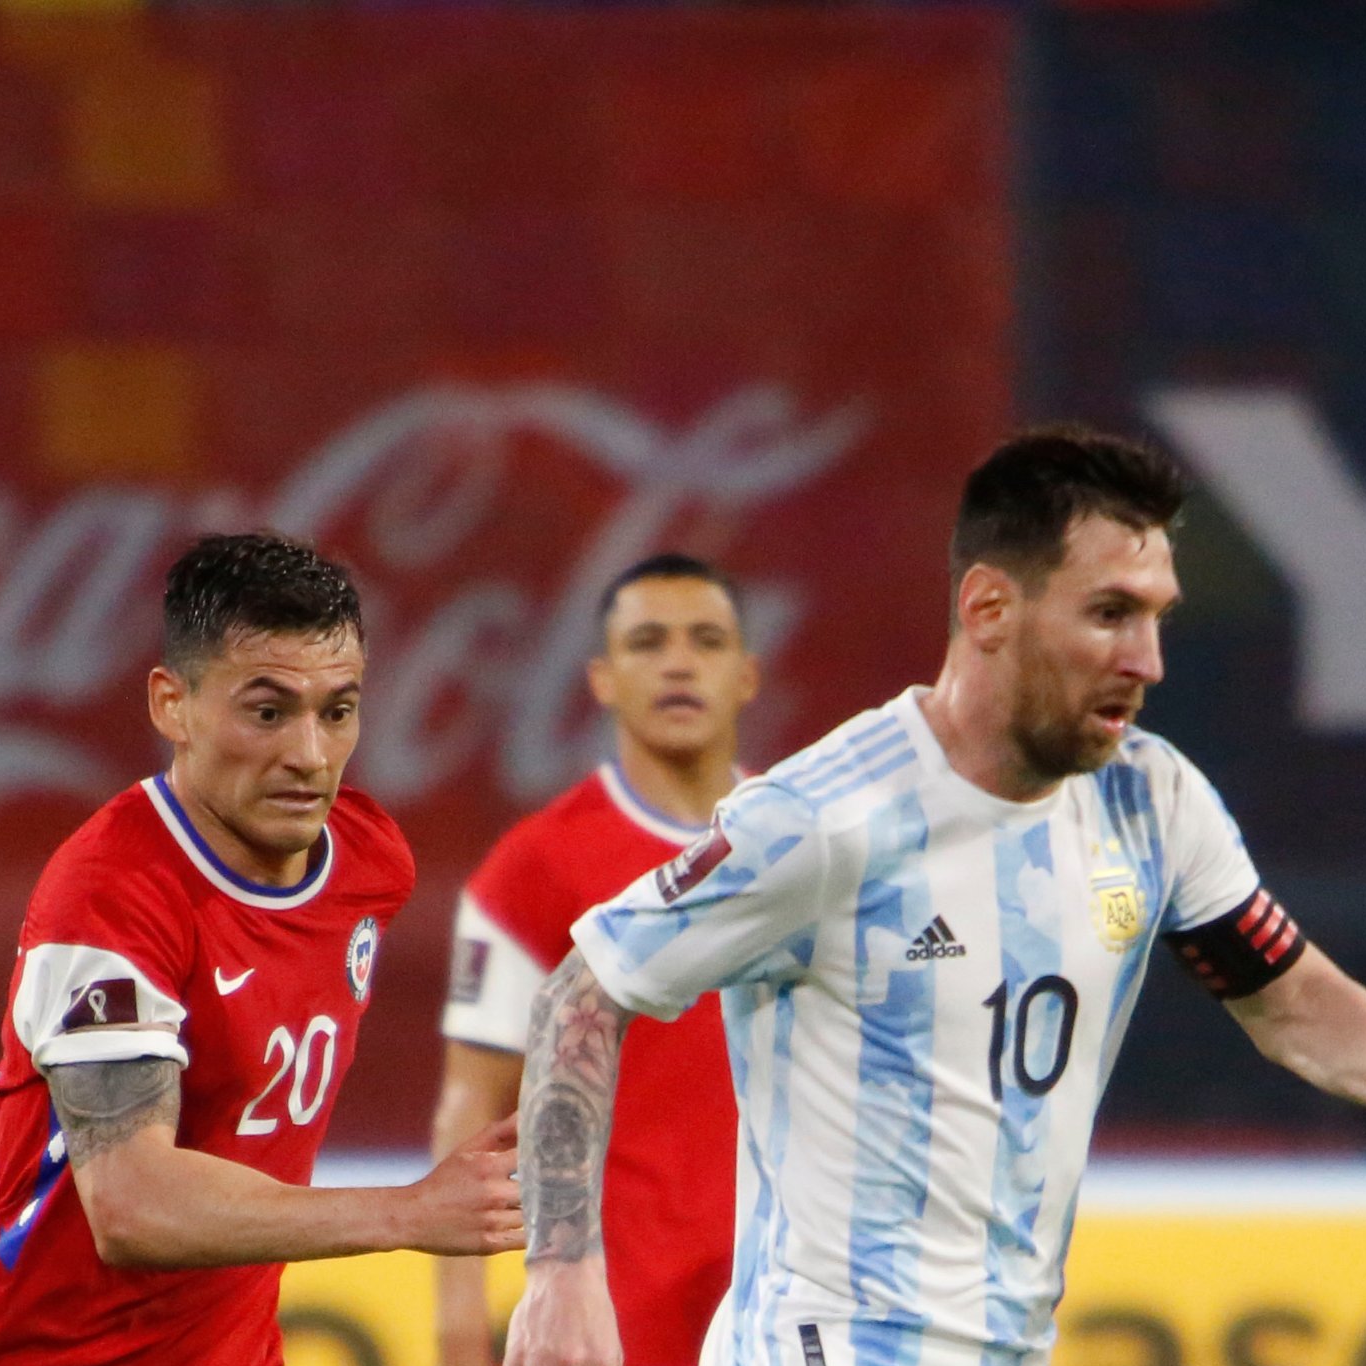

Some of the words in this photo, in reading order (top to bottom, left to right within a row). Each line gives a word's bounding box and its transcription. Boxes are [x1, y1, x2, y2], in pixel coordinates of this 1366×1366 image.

[905, 940, 967, 961] adidas
[235, 1014, 337, 1136] 20
[981, 974, 1079, 1102] 10
